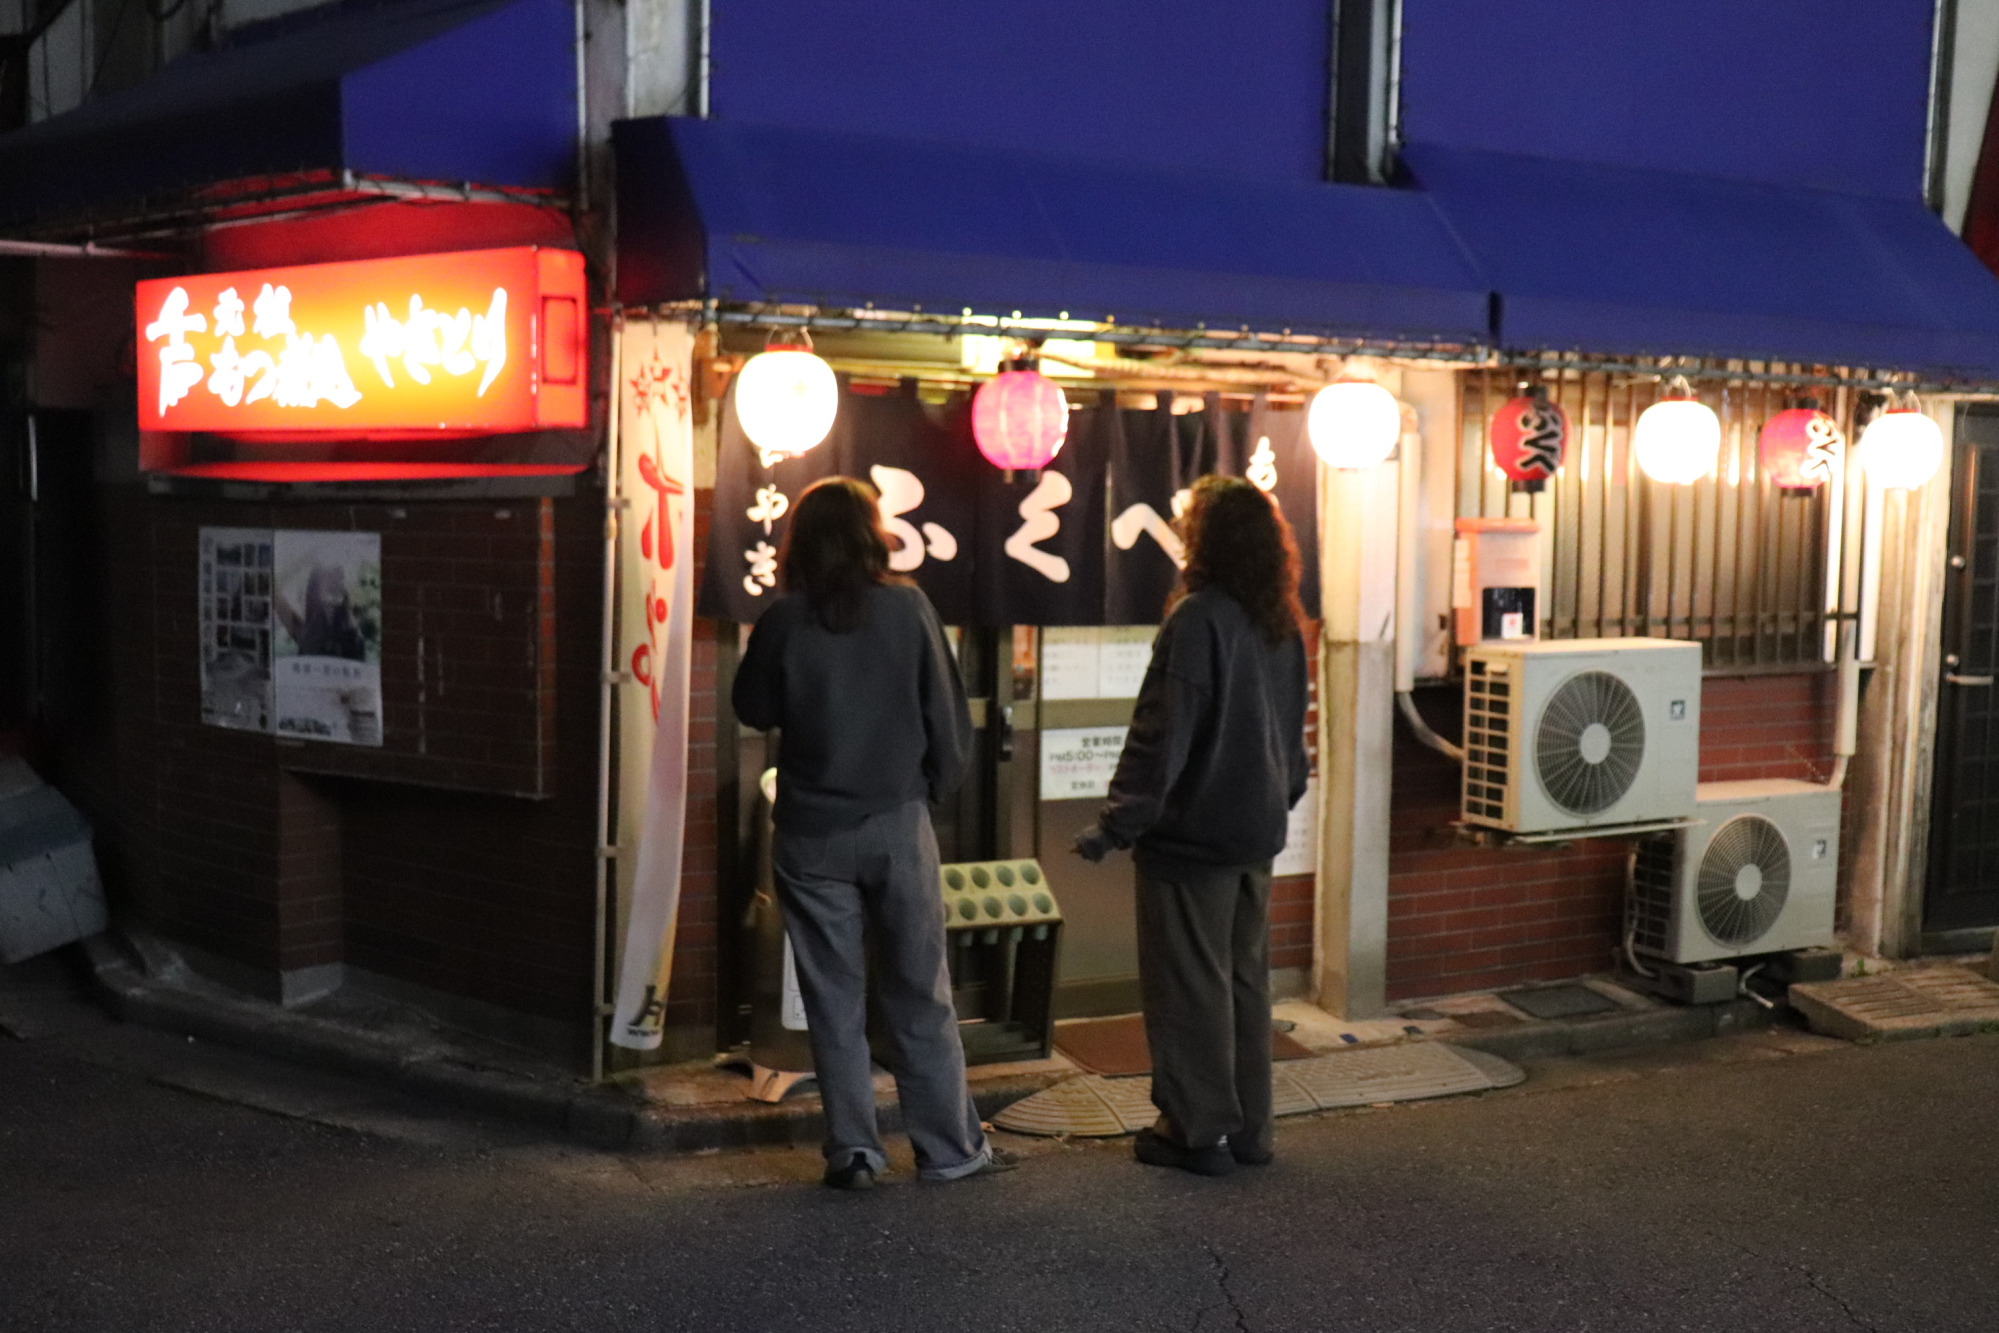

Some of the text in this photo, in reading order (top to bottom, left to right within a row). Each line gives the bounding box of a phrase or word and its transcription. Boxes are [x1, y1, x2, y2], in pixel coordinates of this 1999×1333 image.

[359, 286, 508, 399] やきとり
[1082, 735, 1121, 748] 営業時間
